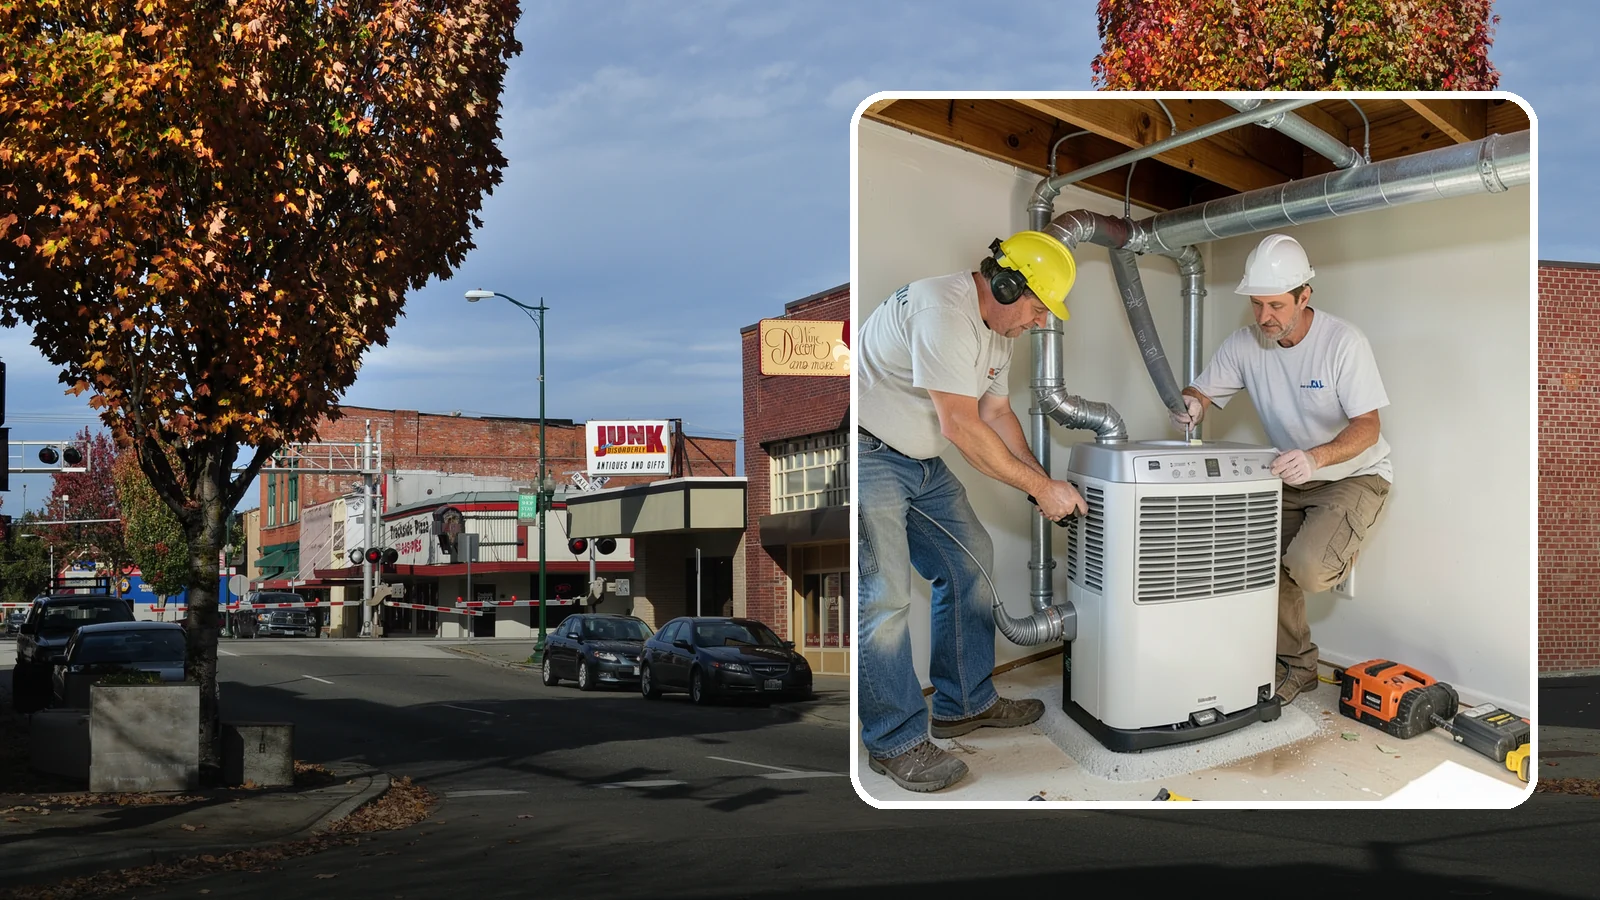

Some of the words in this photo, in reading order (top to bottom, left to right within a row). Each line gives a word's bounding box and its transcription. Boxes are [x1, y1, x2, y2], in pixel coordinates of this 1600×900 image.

[595, 425, 665, 457] JUNK
[607, 446, 646, 454] DISORDERLY
[596, 461, 628, 470] ANTIQUES
[631, 461, 643, 470] AND
[647, 460, 665, 469] GIFTS
[414, 519, 429, 535] Pizza
